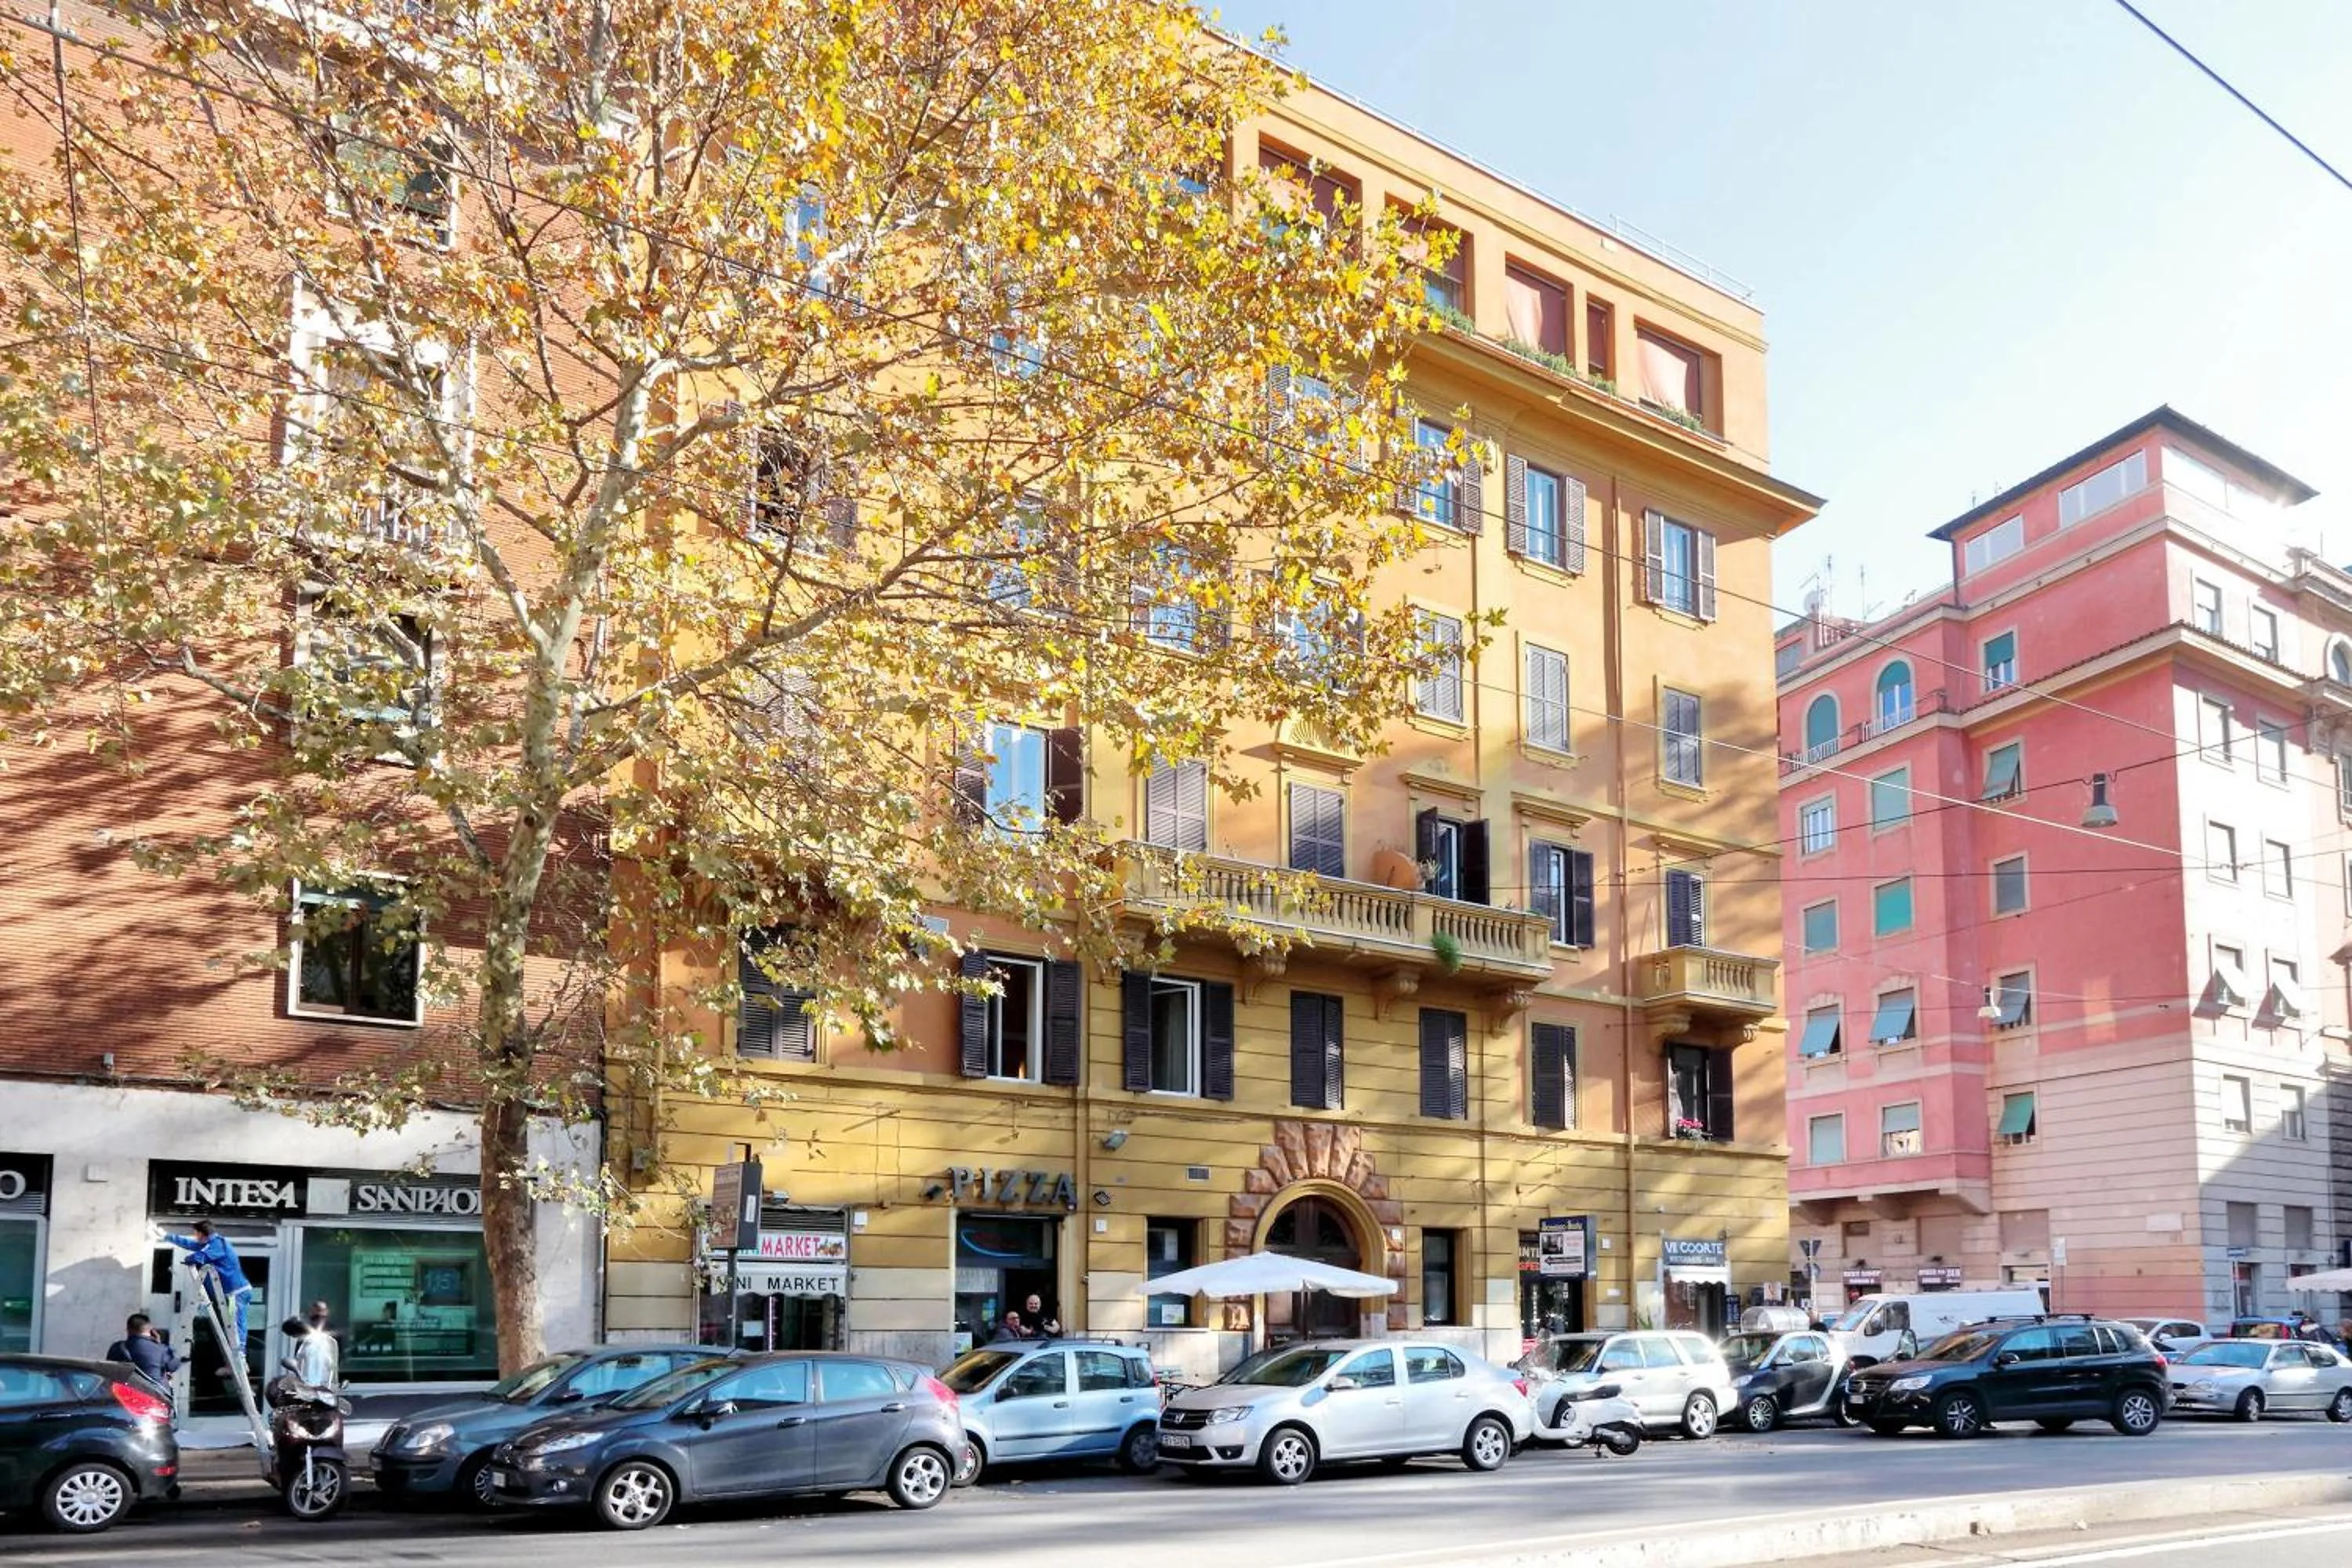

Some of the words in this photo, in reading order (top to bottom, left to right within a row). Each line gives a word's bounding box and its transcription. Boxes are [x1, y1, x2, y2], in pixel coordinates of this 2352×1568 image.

[948, 1167, 1078, 1203] PIZZA
[174, 1177, 299, 1208] INTESA
[357, 1185, 482, 1214] SANPAO
[760, 1236, 822, 1257] MARKET
[1519, 1246, 1540, 1258] INTE
[1680, 1241, 1723, 1254] COORTE
[768, 1276, 839, 1291] MARKET
